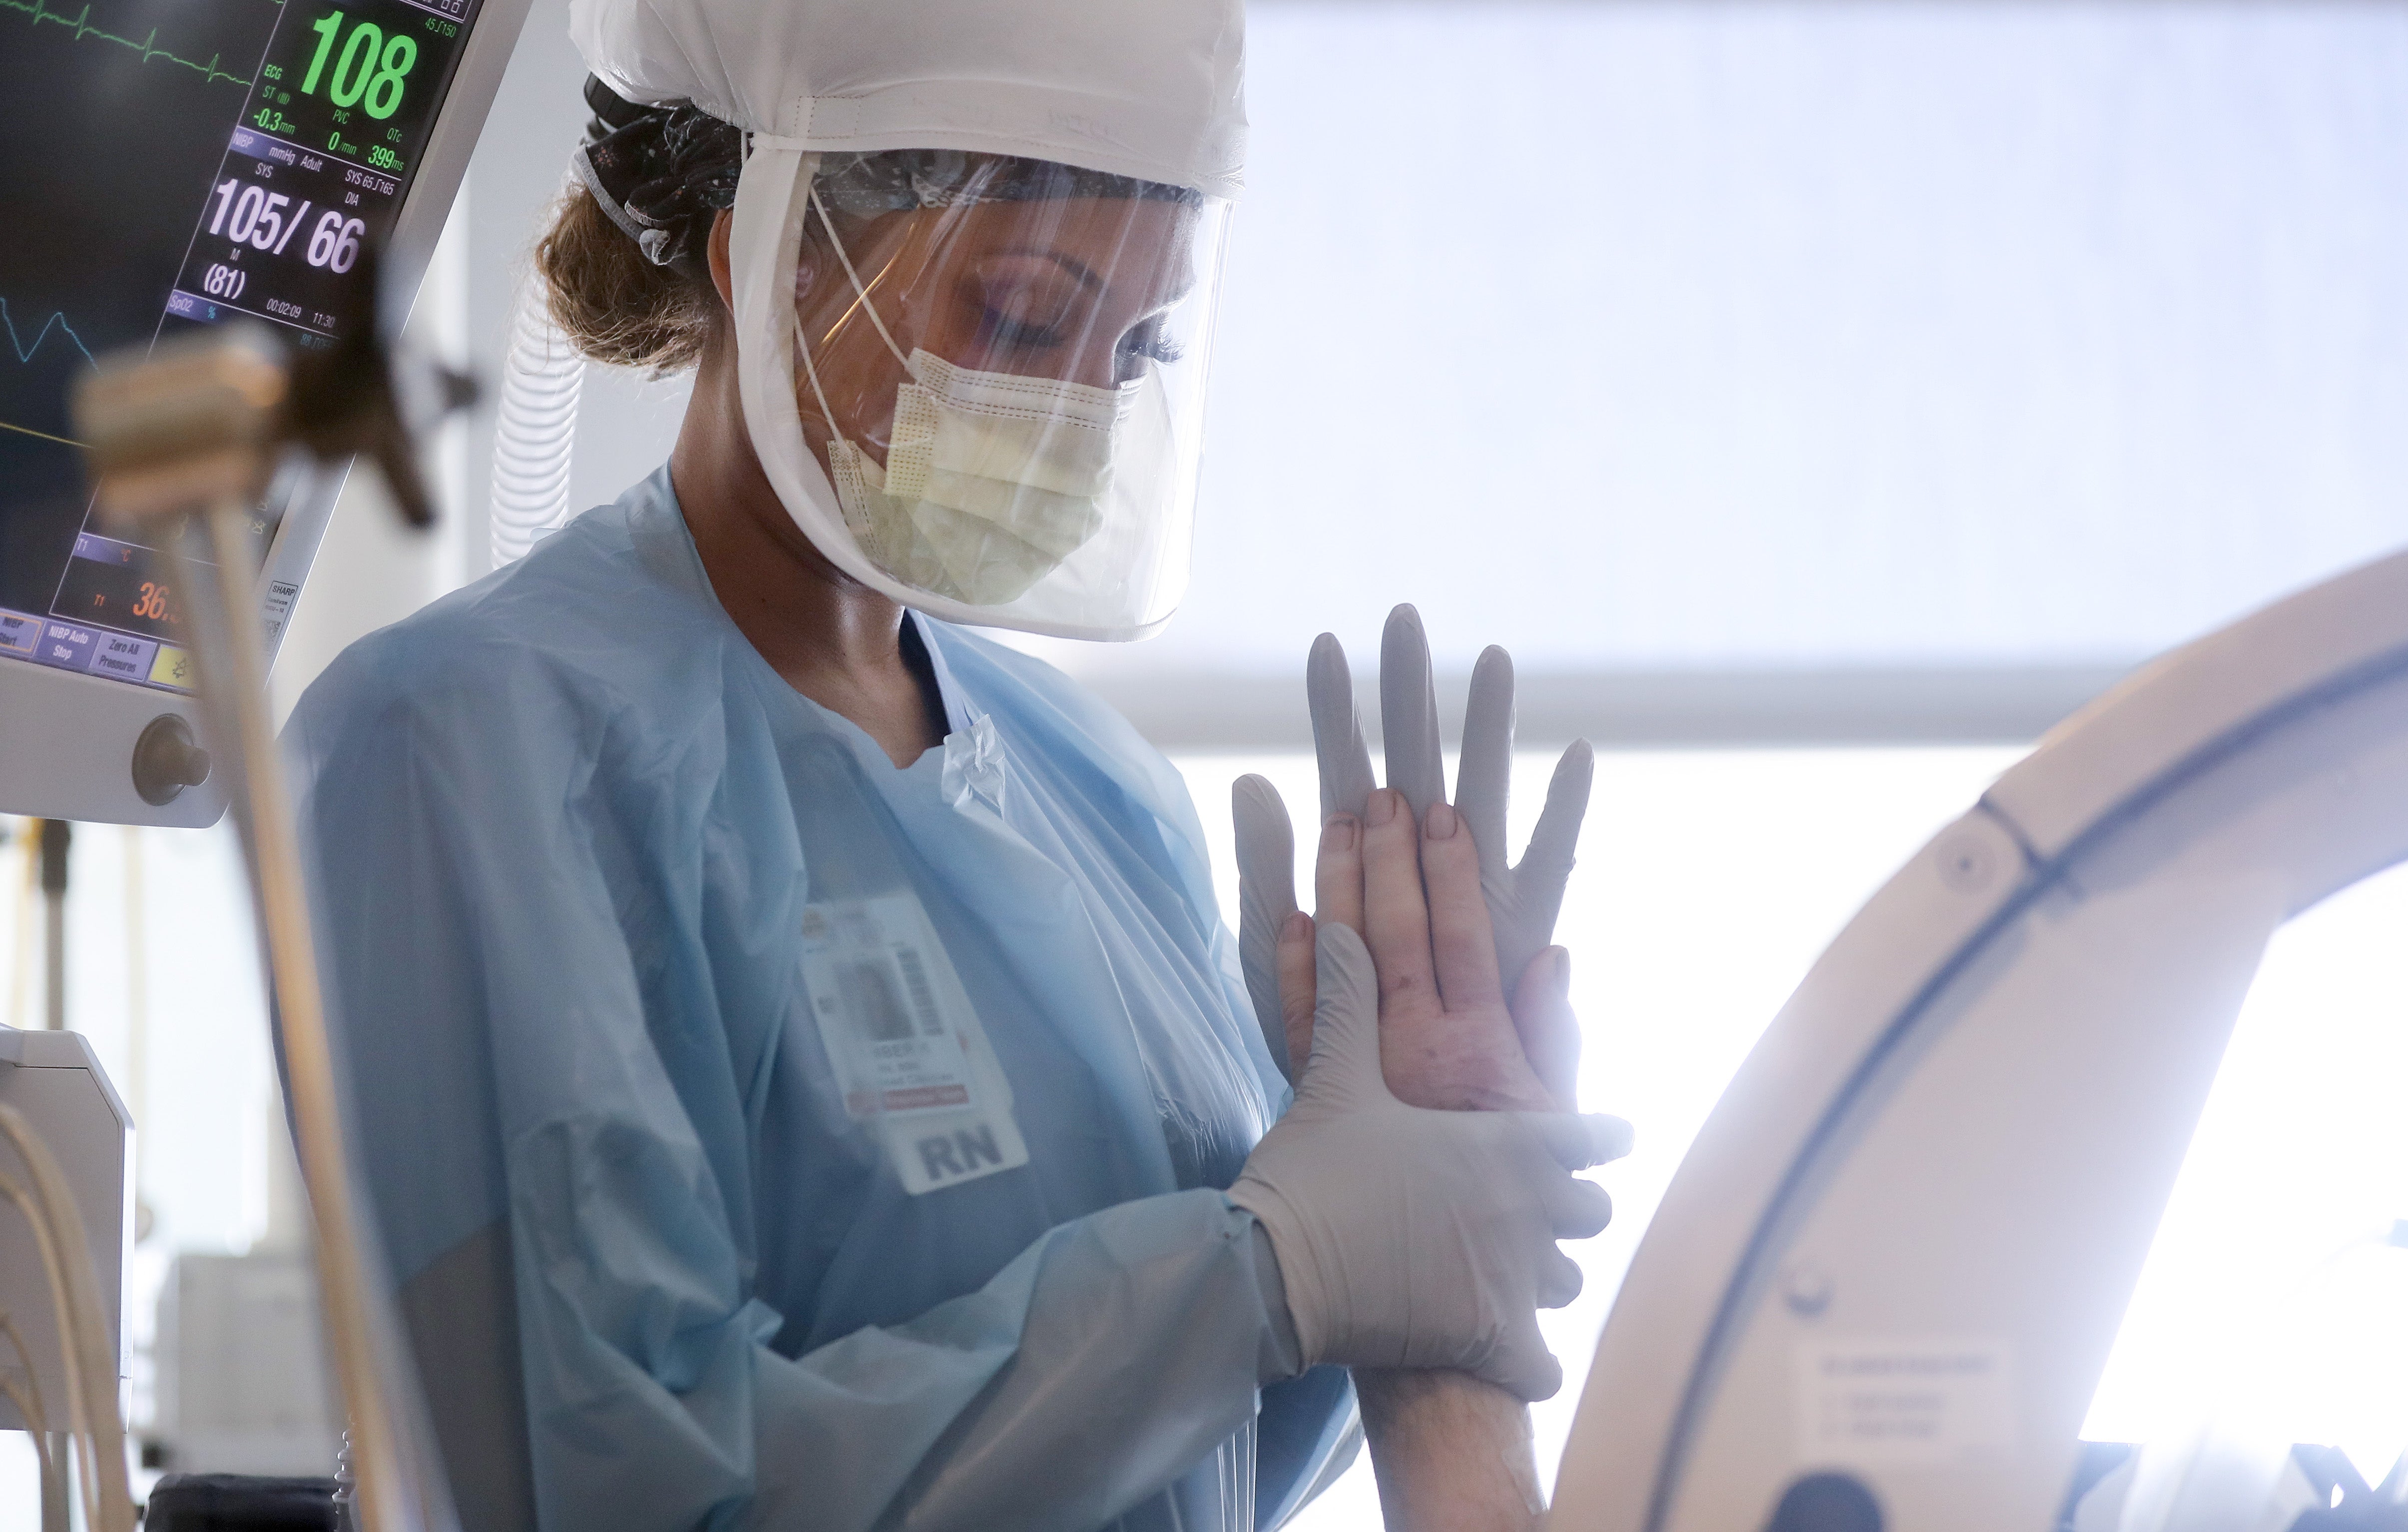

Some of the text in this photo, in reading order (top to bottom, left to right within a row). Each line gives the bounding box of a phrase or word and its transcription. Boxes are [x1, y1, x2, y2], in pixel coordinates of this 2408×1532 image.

[264, 64, 283, 80] ECG
[301, 10, 418, 120] 108
[262, 85, 276, 99] ST
[333, 109, 349, 124] PVC
[328, 132, 340, 150] 0
[233, 132, 323, 172] NIBP mmHg Adult
[255, 162, 273, 178] SYS
[345, 169, 362, 185] SYS
[345, 192, 359, 206] DIA
[307, 211, 366, 274] 66
[230, 248, 241, 261] M
[204, 263, 245, 299] (81)
[169, 295, 216, 319] SpO2 %
[266, 298, 336, 328] 00:02:09 11:30
[77, 538, 89, 551] T1
[272, 585, 295, 596] SHARP
[94, 594, 105, 606] T1
[48, 625, 89, 644] NIBP Auto
[53, 644, 72, 661] Stop
[108, 639, 140, 655] Zero All
[99, 654, 136, 673] Pressures
[916, 1123, 1003, 1181] RN
